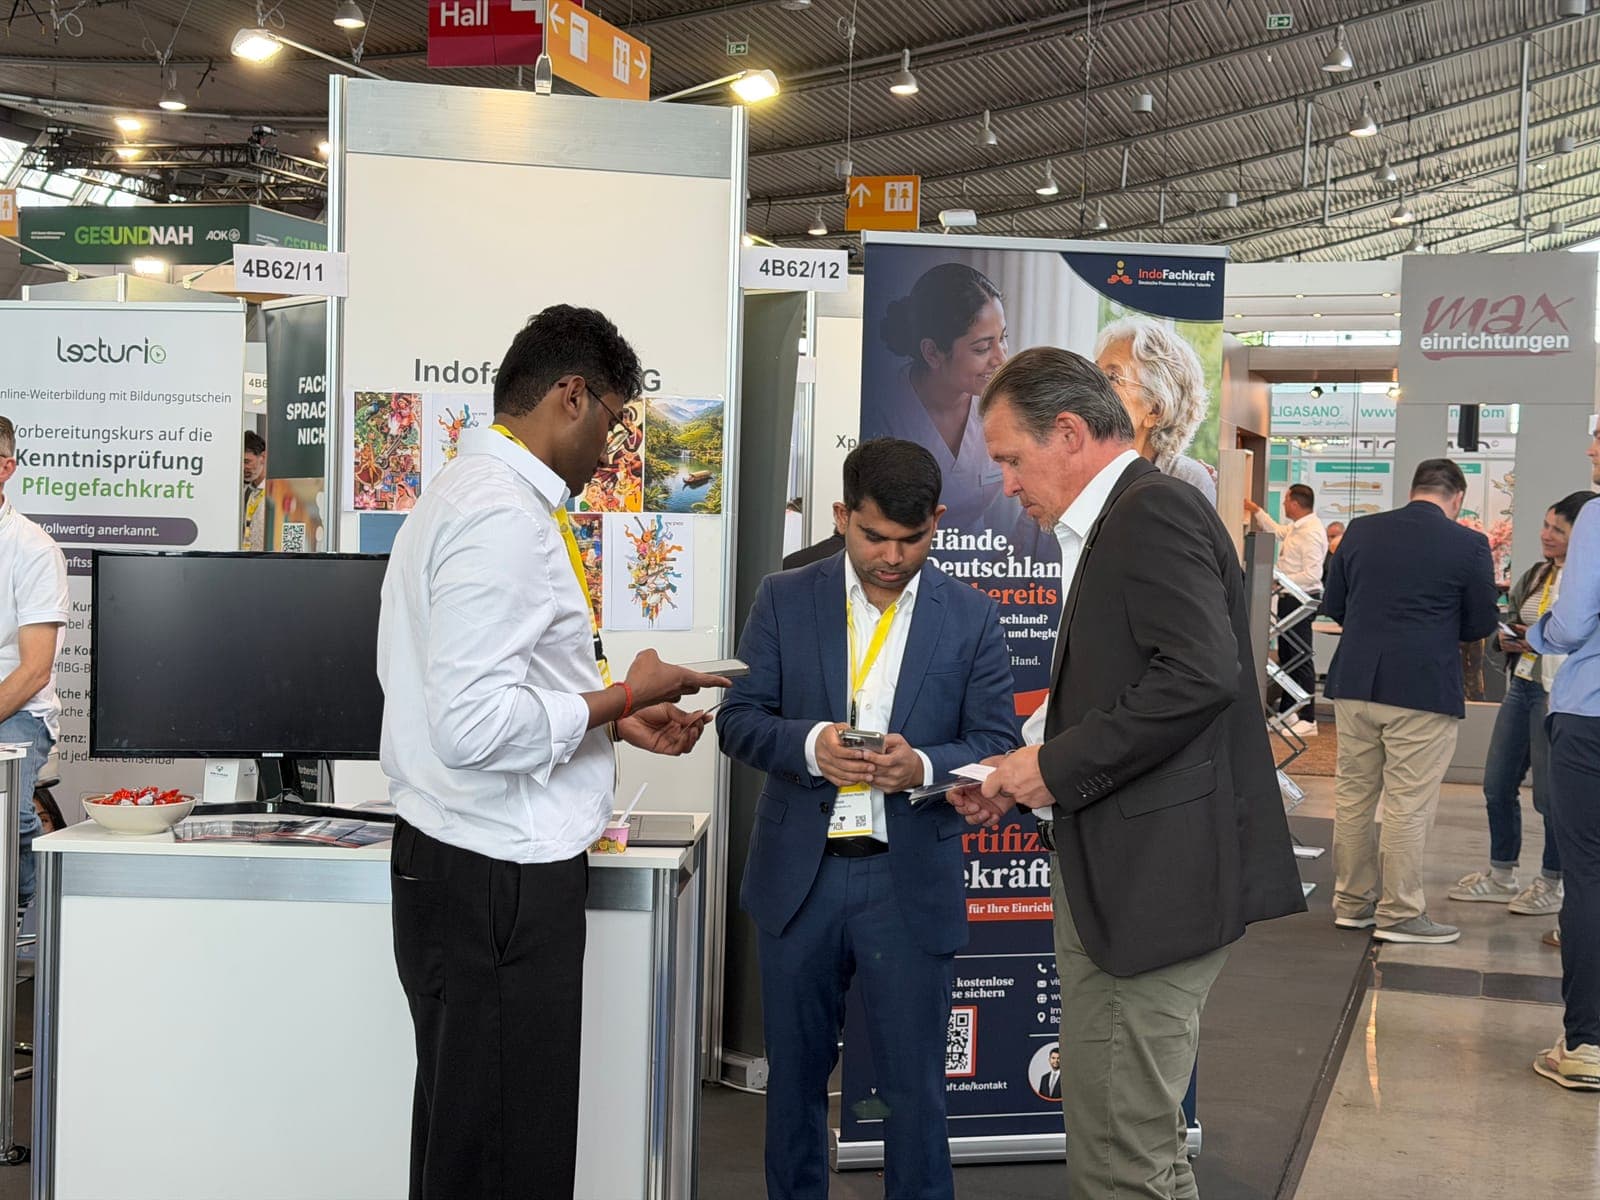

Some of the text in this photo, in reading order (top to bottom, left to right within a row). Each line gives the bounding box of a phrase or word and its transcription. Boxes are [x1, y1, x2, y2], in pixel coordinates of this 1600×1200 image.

[440, 1, 489, 27] Hall
[74, 226, 194, 246] GESUNDNAH
[205, 230, 229, 242] AOK
[242, 258, 324, 282] 4B62/11
[759, 259, 840, 279] 4B62/12
[1138, 268, 1216, 281] IndoFachkraft
[1421, 292, 1576, 335] max
[56, 336, 167, 364] lecturio
[1420, 332, 1570, 353] einrichtungen
[109, 391, 127, 402] mit
[130, 390, 232, 405] Bildungsgutschein
[286, 401, 326, 421] SPRAC
[1271, 406, 1340, 418] LIGASANO
[158, 427, 185, 441] auf
[188, 427, 213, 442] die
[16, 449, 204, 476] Kenntnisprüfung
[22, 477, 195, 502] Pflegefachkraft
[97, 524, 160, 537] anerkannt.
[930, 528, 1015, 556] Hände,
[1008, 629, 1028, 639] und
[54, 661, 92, 673] flBG-B
[1011, 656, 1041, 666] Hand.
[961, 823, 1048, 853] rtifiz
[968, 904, 986, 914] für
[987, 904, 1010, 914] Ihre
[957, 976, 1015, 987] kostenlose
[964, 987, 1006, 999] sichern
